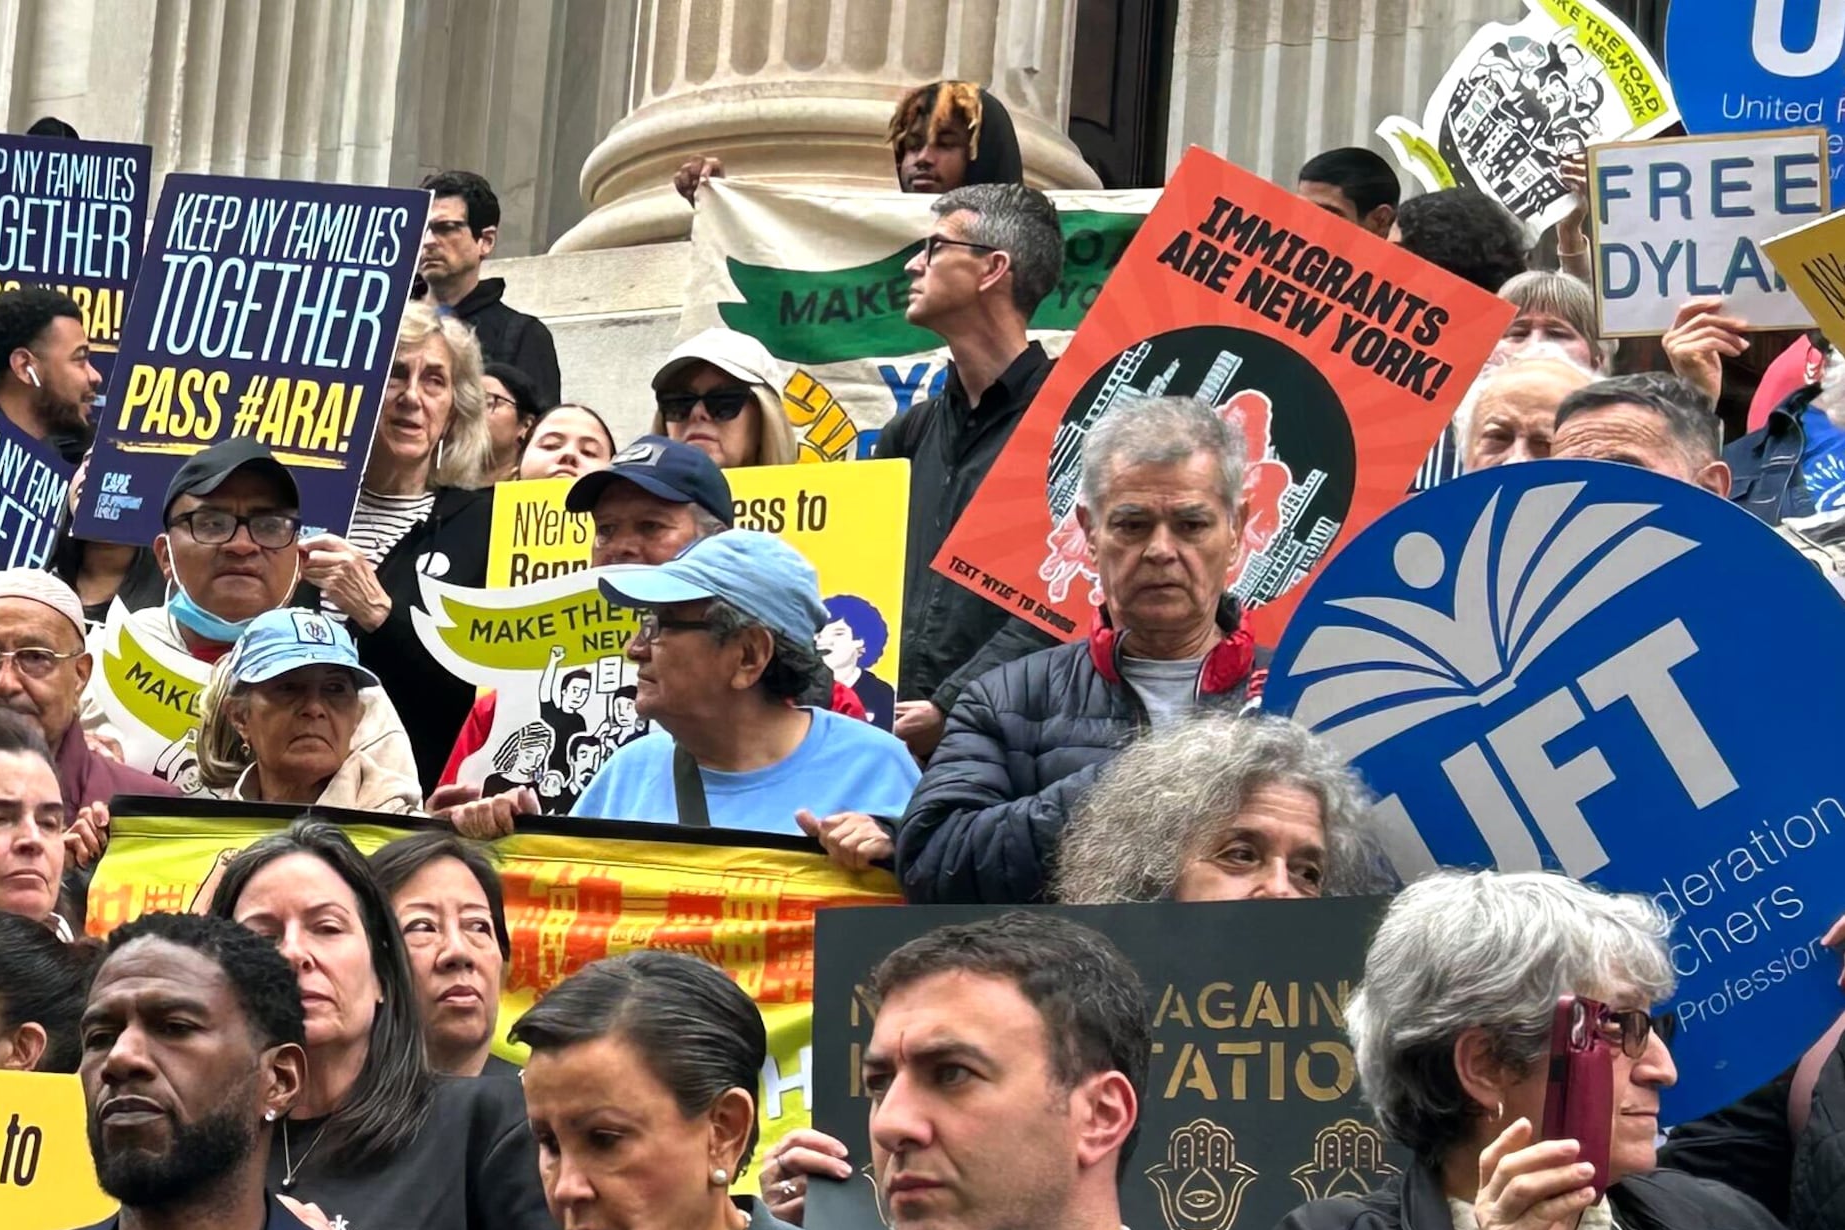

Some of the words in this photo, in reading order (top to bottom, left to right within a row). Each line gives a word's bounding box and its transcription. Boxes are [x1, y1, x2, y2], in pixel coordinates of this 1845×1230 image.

[1585, 16, 1622, 53] THE
[1618, 52, 1660, 112] ROAD
[1586, 37, 1621, 71] NEW
[1620, 74, 1646, 118] YORK
[1722, 92, 1825, 124] United
[11, 149, 45, 195] NY
[47, 151, 137, 203] FAMILIES
[1598, 153, 1821, 225] FREE
[166, 192, 240, 255] KEEP
[244, 198, 289, 257] NY
[286, 202, 409, 269] FAMILIES
[1601, 236, 1789, 299] DYLA
[1200, 196, 1451, 347] IMMIGRANTS
[39, 283, 125, 341] RA!
[146, 254, 392, 373] TOGETHER
[1156, 230, 1241, 298] ARE
[1239, 266, 1331, 341] NEW
[1328, 311, 1456, 402] YORK!
[117, 364, 231, 442] PASS
[232, 375, 365, 453] #ARA!
[513, 500, 588, 548] NYers
[733, 494, 786, 532] ess
[797, 489, 827, 531] to
[469, 613, 558, 644] MAKE
[561, 599, 621, 631] THE
[1370, 617, 1741, 882] UFT
[1154, 979, 1350, 1029] AGAIN
[0, 1113, 44, 1187] to
